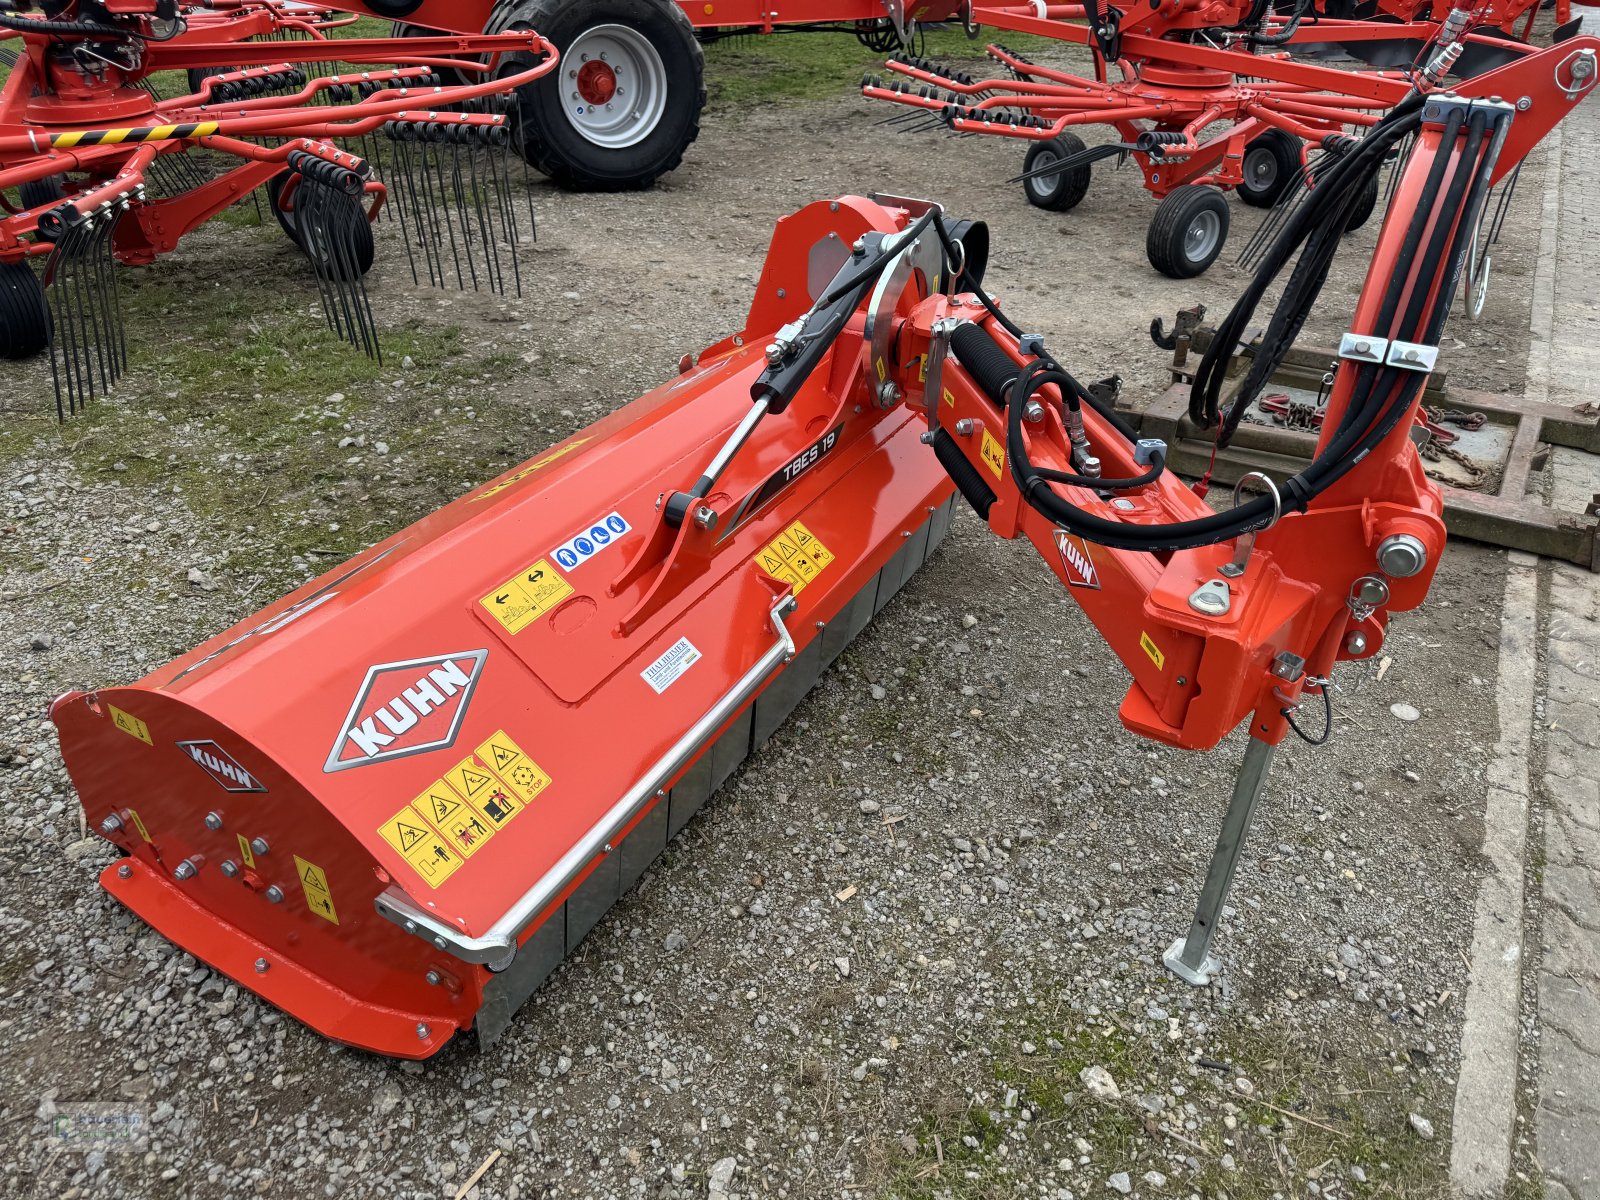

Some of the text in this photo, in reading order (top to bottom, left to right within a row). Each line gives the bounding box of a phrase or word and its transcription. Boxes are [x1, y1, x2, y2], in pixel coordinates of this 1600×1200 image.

[783, 432, 835, 481] TBES 19
[1059, 533, 1093, 585] KUHN
[645, 641, 687, 677] THALHEIMER
[346, 659, 471, 758] KUHN
[189, 744, 252, 789] KUHN
[526, 778, 544, 796] STOP
